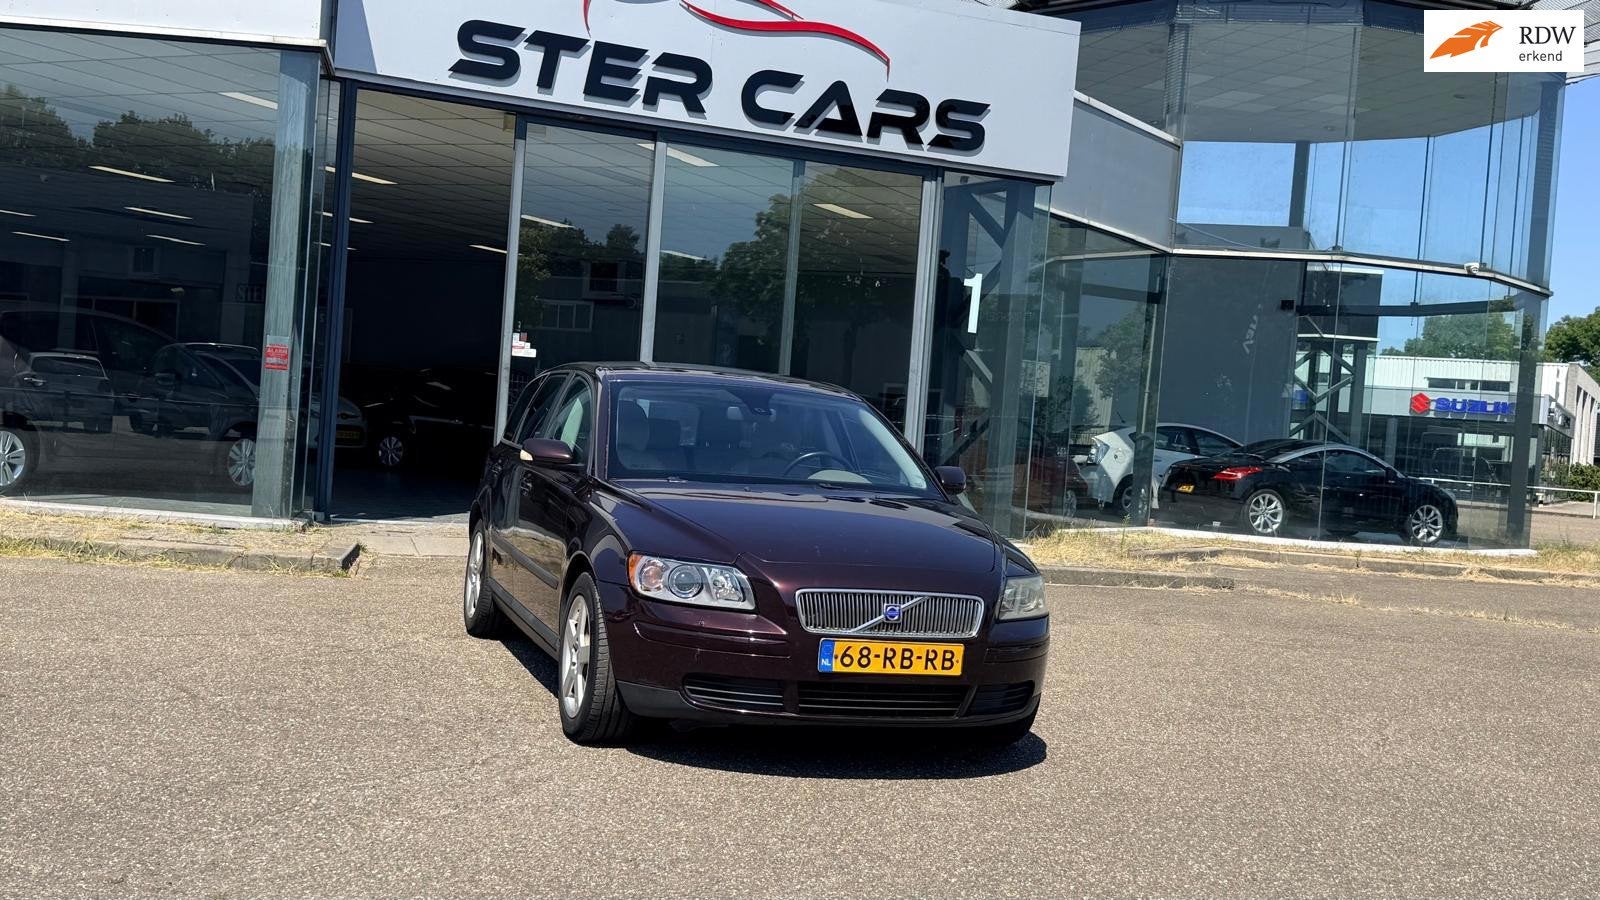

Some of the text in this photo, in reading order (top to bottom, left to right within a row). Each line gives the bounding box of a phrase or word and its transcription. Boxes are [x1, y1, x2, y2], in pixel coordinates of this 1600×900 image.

[448, 19, 991, 152] STER CARS
[963, 273, 983, 334] 1
[821, 658, 832, 667] NL
[839, 645, 956, 671] 68-RB-RB
